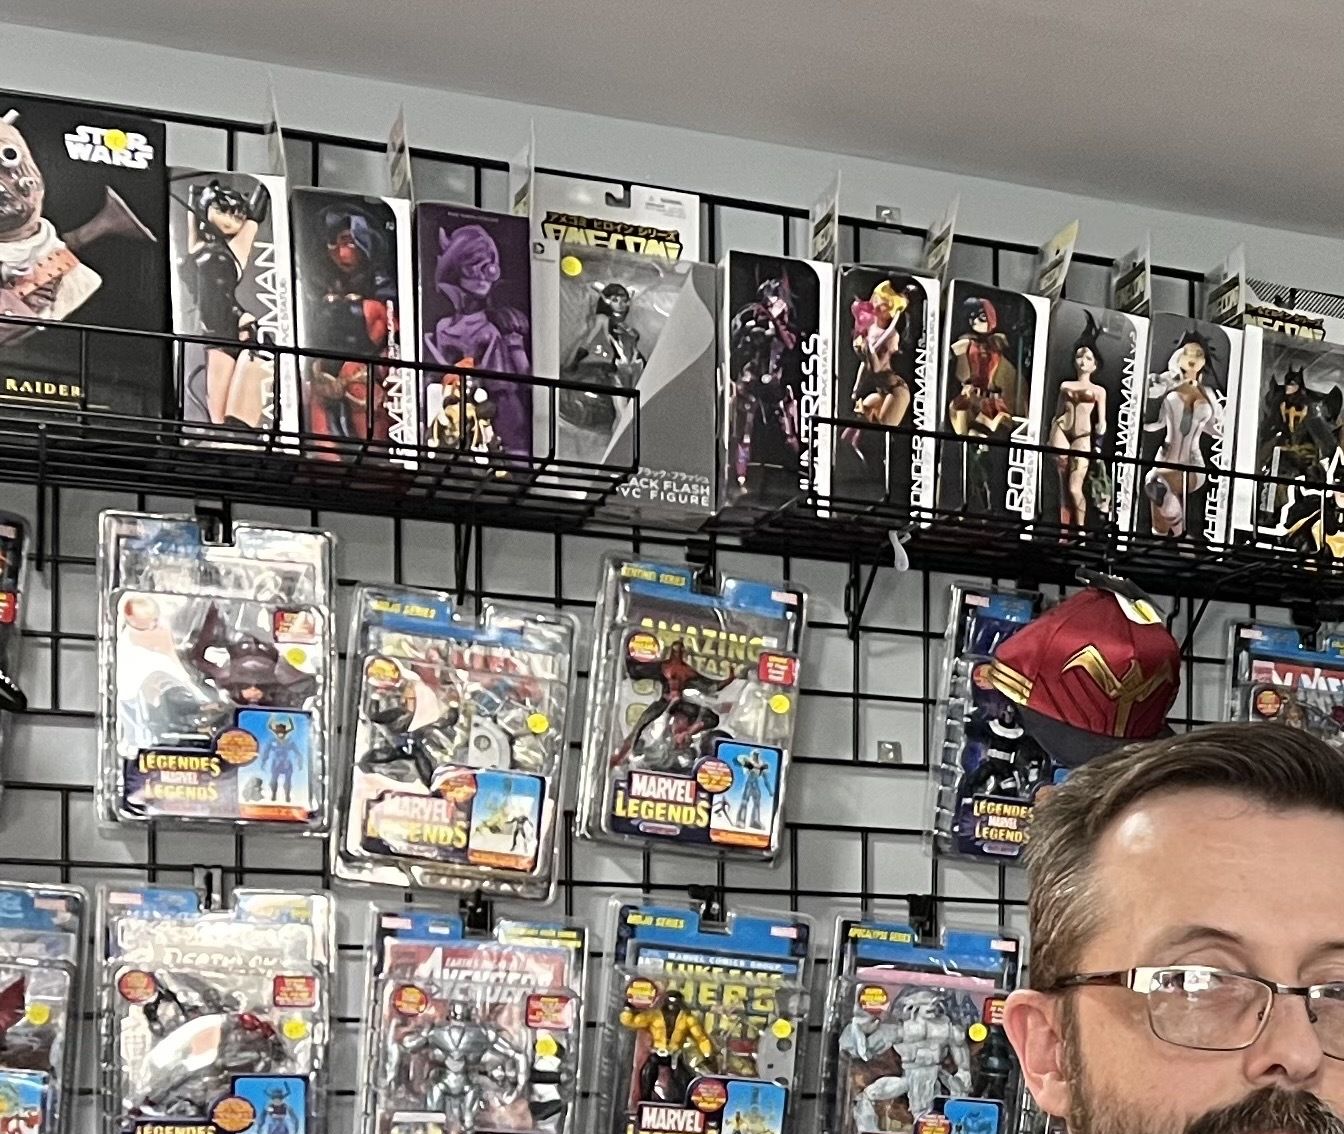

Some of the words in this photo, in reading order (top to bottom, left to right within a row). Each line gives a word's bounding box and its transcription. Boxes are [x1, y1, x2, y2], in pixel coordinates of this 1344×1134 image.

[65, 126, 153, 152] STR
[65, 140, 153, 170] WARS
[6, 378, 82, 397] RAIDER
[650, 489, 710, 507] FIGURE
[664, 480, 711, 496] FLASH
[631, 774, 696, 803] MARVEL
[615, 791, 711, 827] LEGENDS
[975, 821, 1030, 844] LEGENDS
[641, 1107, 705, 1133] MARVEL
